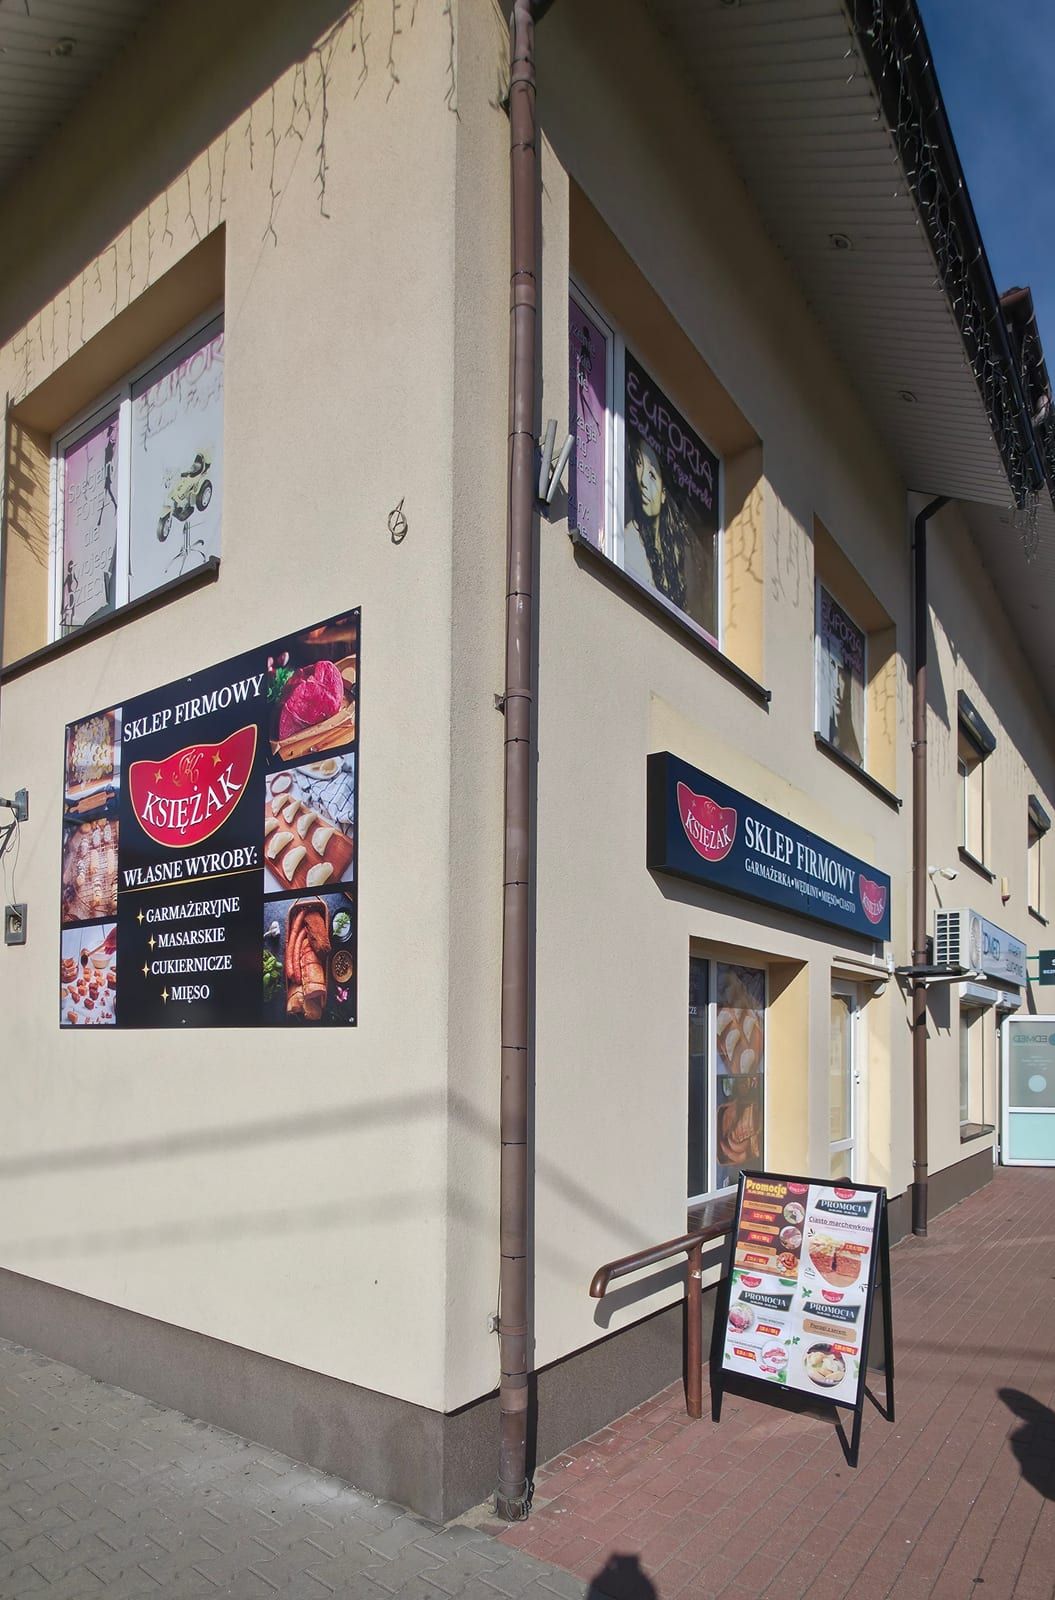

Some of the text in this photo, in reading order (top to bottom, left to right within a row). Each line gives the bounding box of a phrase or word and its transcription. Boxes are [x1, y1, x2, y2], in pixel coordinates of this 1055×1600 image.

[123, 673, 265, 743] SKLEP FIRMOWY
[142, 763, 242, 834] KSIĘŻAK
[685, 810, 732, 851] KSIĘŻAK
[123, 846, 259, 887] WŁASNE WYROBY:
[745, 816, 856, 894] SKLEP FIRMOWY
[146, 896, 240, 924] GARMAŻERYJNE
[158, 927, 225, 948] MASARSKIE
[151, 954, 232, 976] CUKIERNICZE
[171, 985, 210, 1003] MIĘSO
[746, 1179, 787, 1195] Promocja
